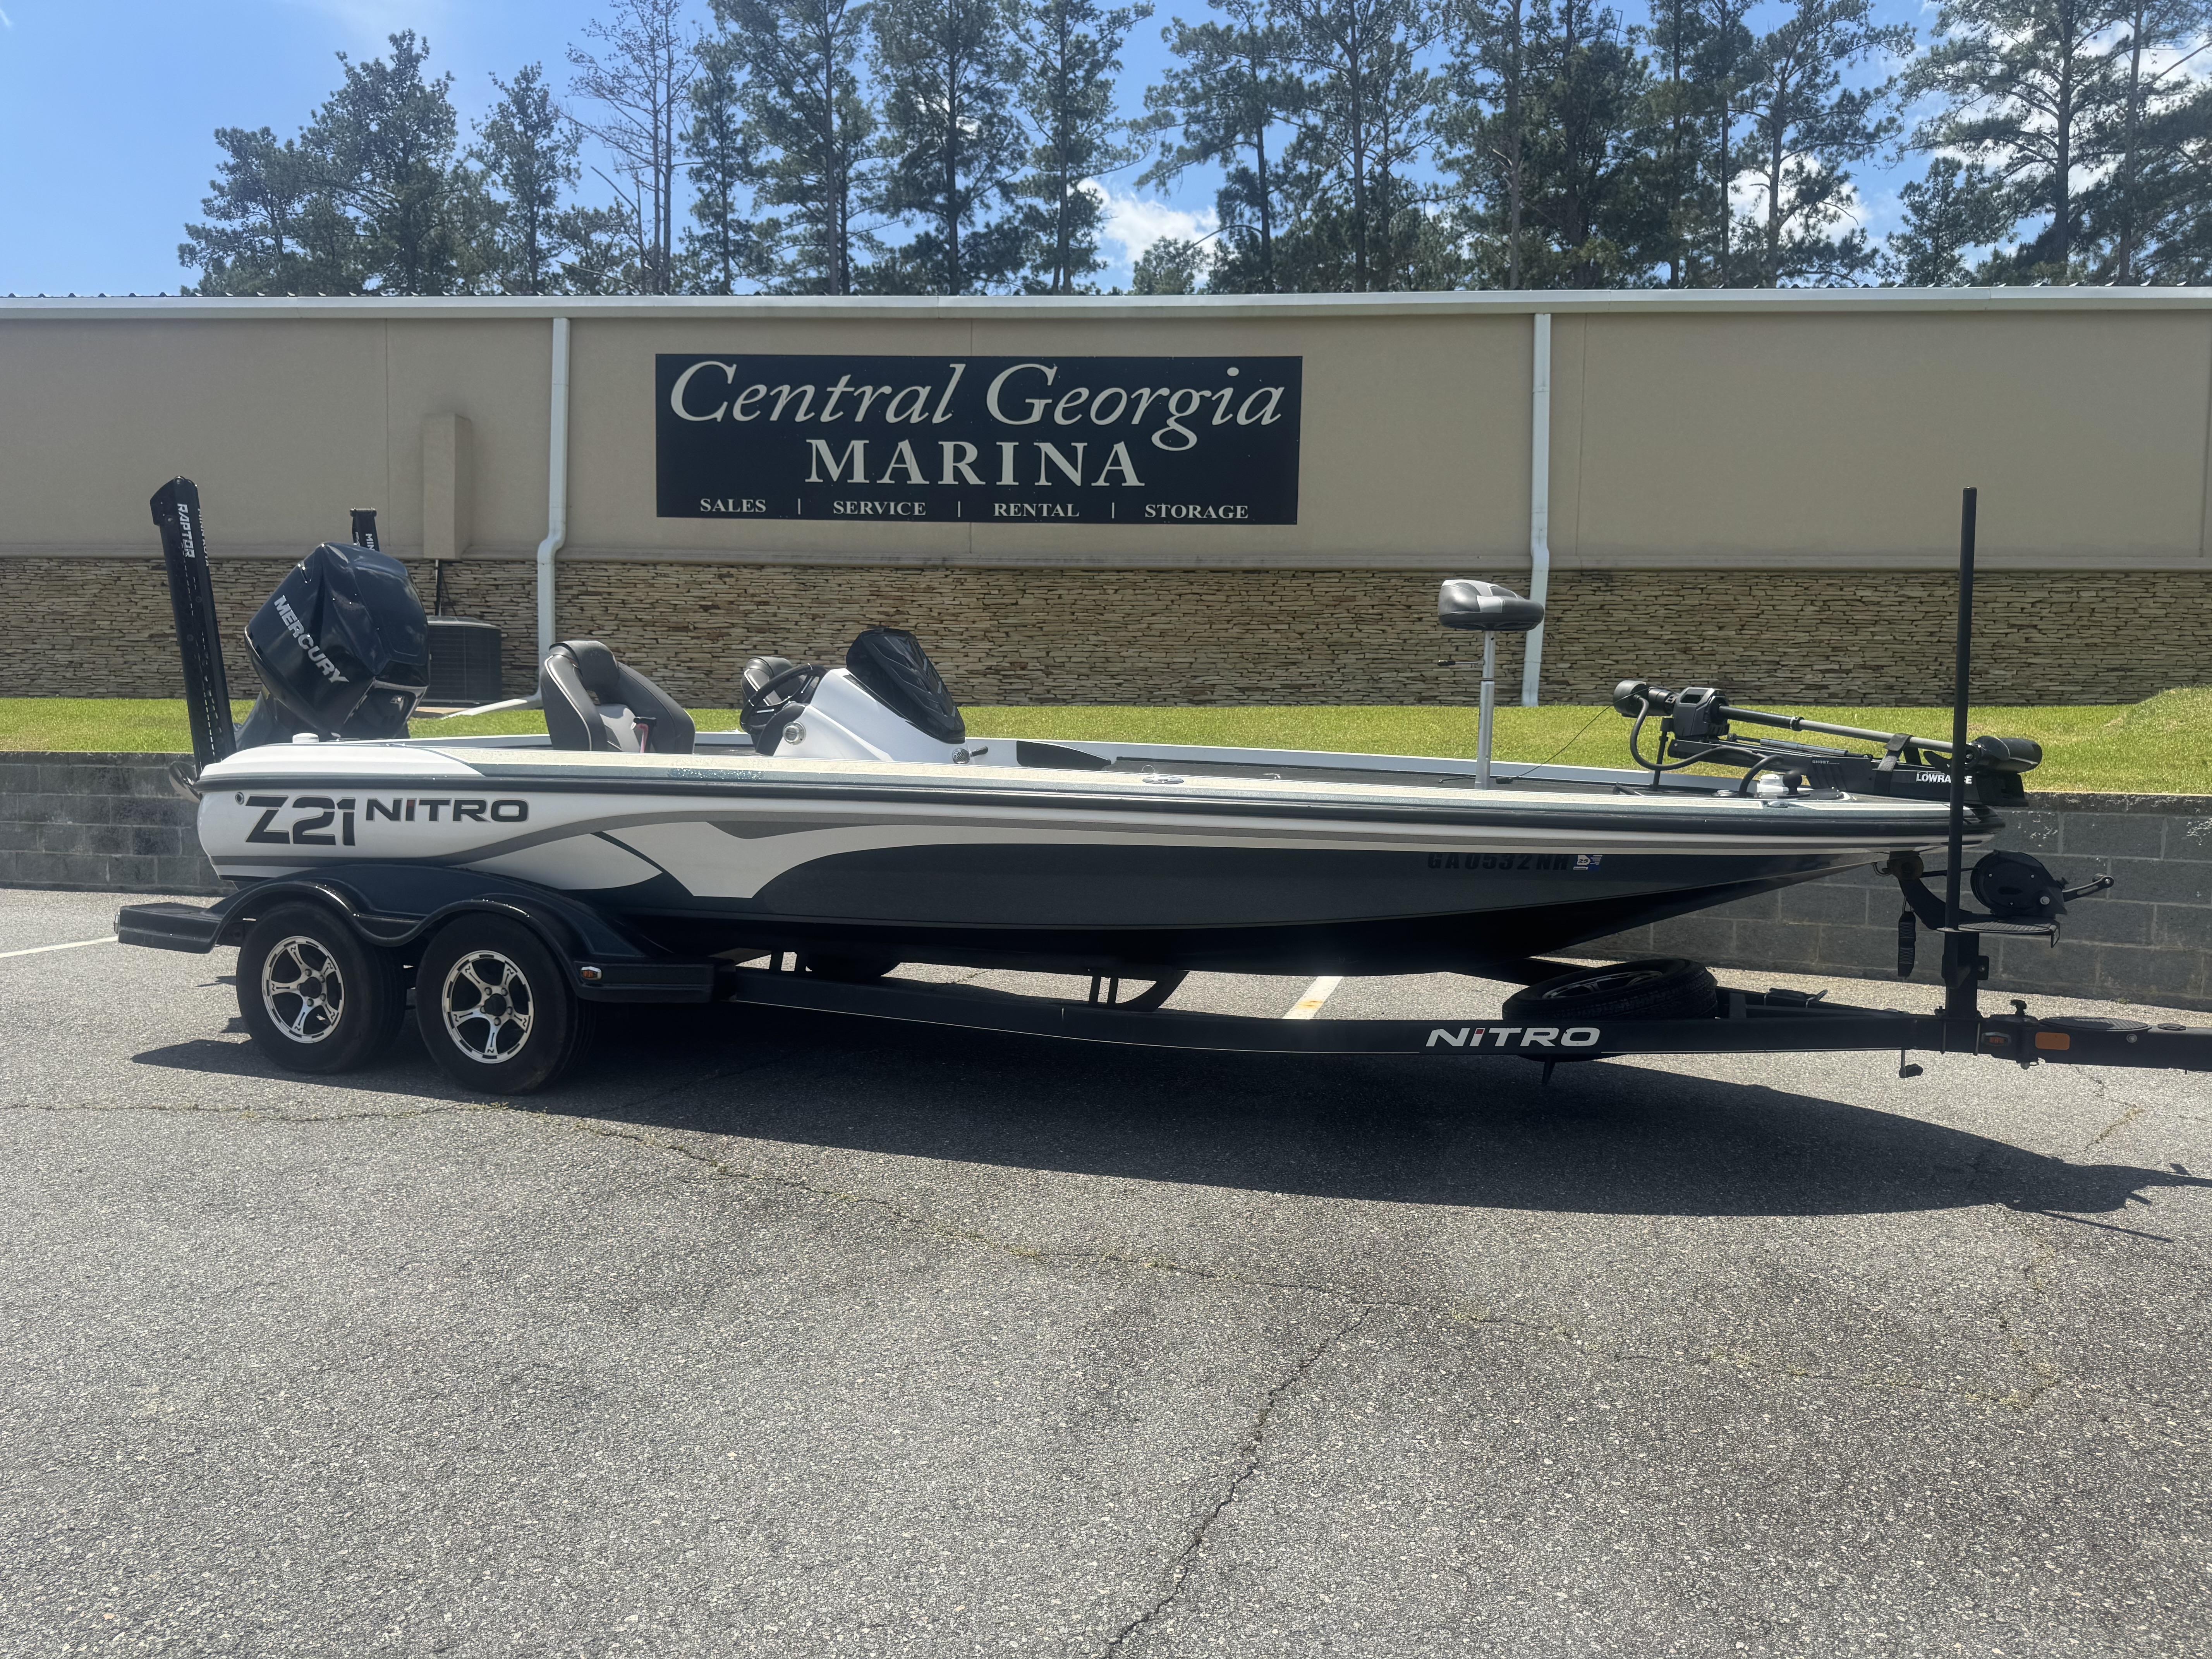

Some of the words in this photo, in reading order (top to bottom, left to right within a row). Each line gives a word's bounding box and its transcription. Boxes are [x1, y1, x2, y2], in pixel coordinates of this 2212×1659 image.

[670, 361, 966, 424] Central
[986, 364, 1284, 451] Georgia
[805, 439, 1145, 486] MARINA
[700, 498, 766, 513] SALES
[833, 501, 926, 515] SERVICE
[994, 503, 1080, 517] RENTAL
[1145, 503, 1249, 519] STORAGE
[177, 503, 195, 558] RAPTOR
[365, 533, 375, 551] MIN
[274, 595, 350, 684] MERCURY
[1916, 773, 1973, 784] LOWRAE
[245, 795, 356, 846] Z21
[366, 797, 530, 823] NITRO
[1425, 1027, 1601, 1047] NITRO
